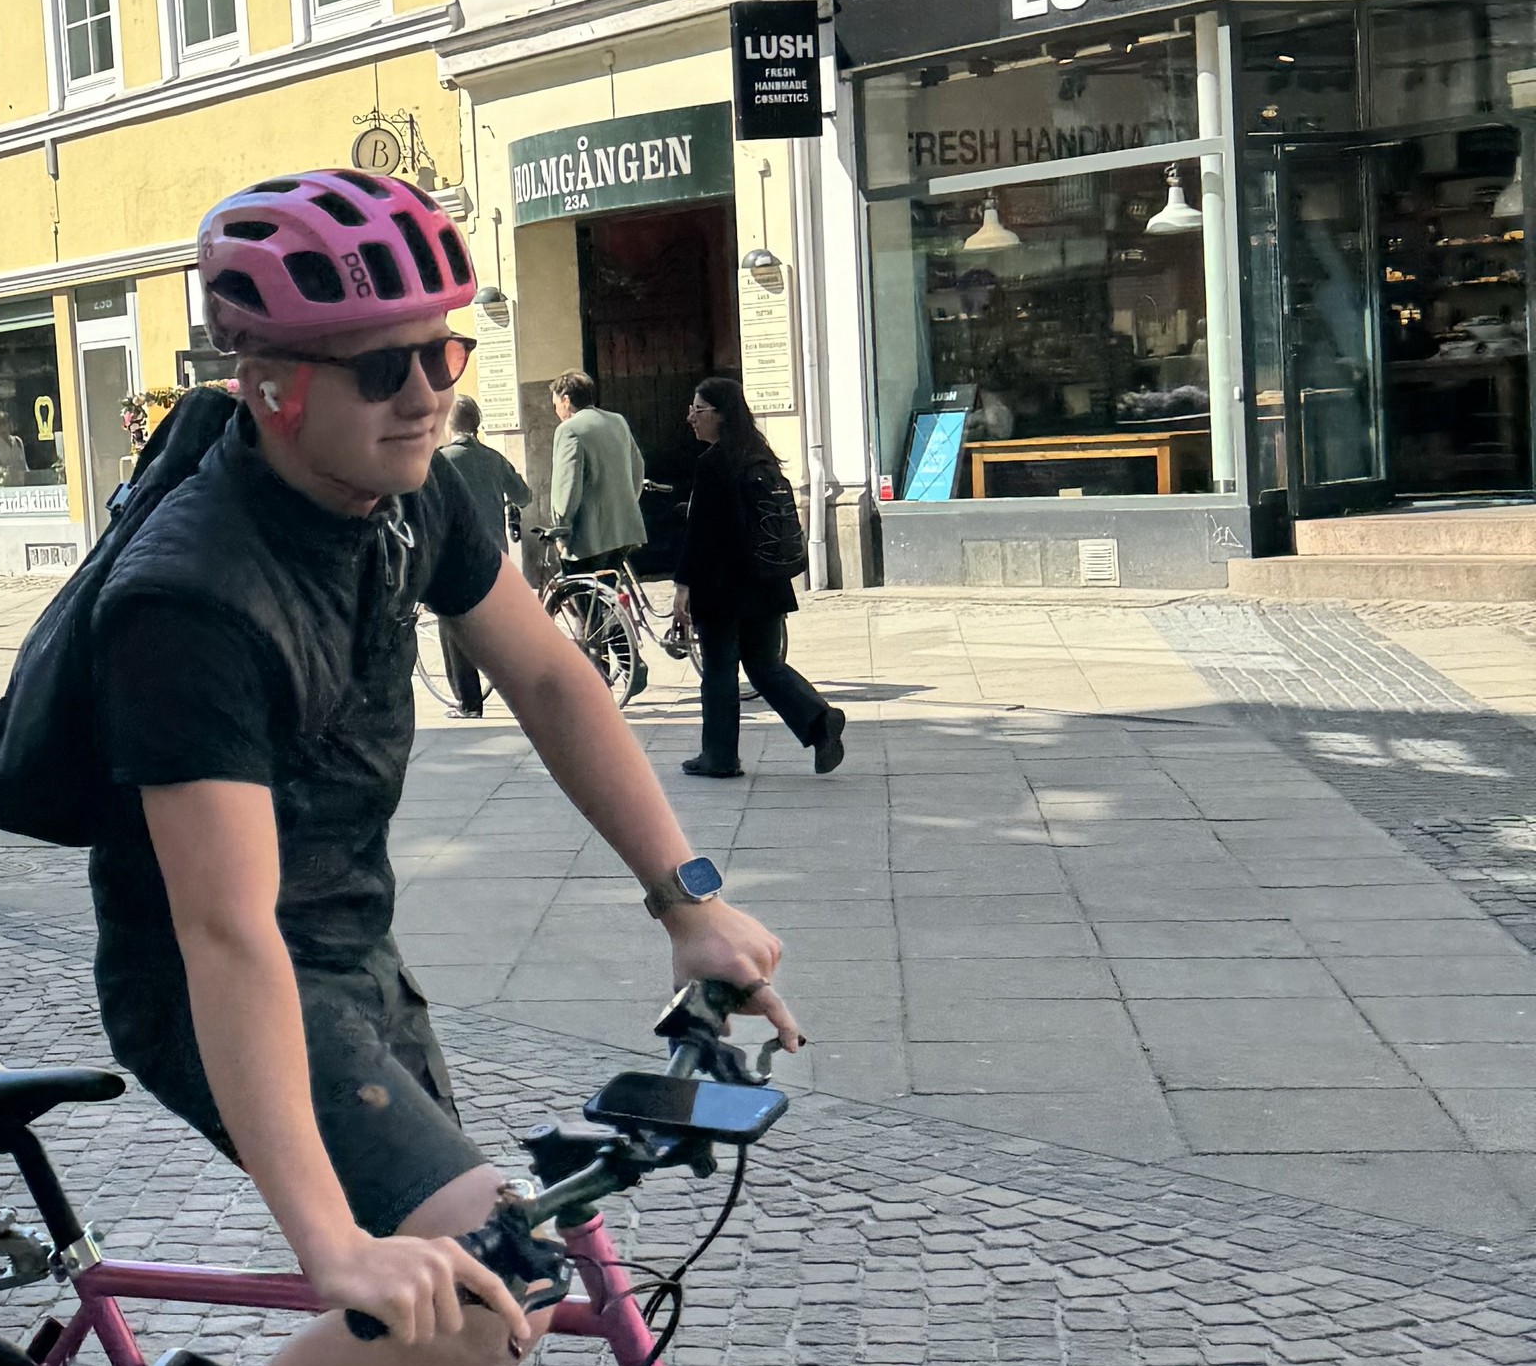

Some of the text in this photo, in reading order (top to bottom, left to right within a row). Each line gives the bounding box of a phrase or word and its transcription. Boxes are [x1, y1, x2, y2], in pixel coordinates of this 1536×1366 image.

[744, 34, 814, 60] LUSH
[765, 67, 796, 78] FRESH
[754, 80, 808, 92] HANDMADE
[754, 93, 809, 104] COSMETICS
[371, 139, 389, 168] B
[513, 135, 692, 204] HOLMGÅNGEN
[564, 193, 589, 211] 23A
